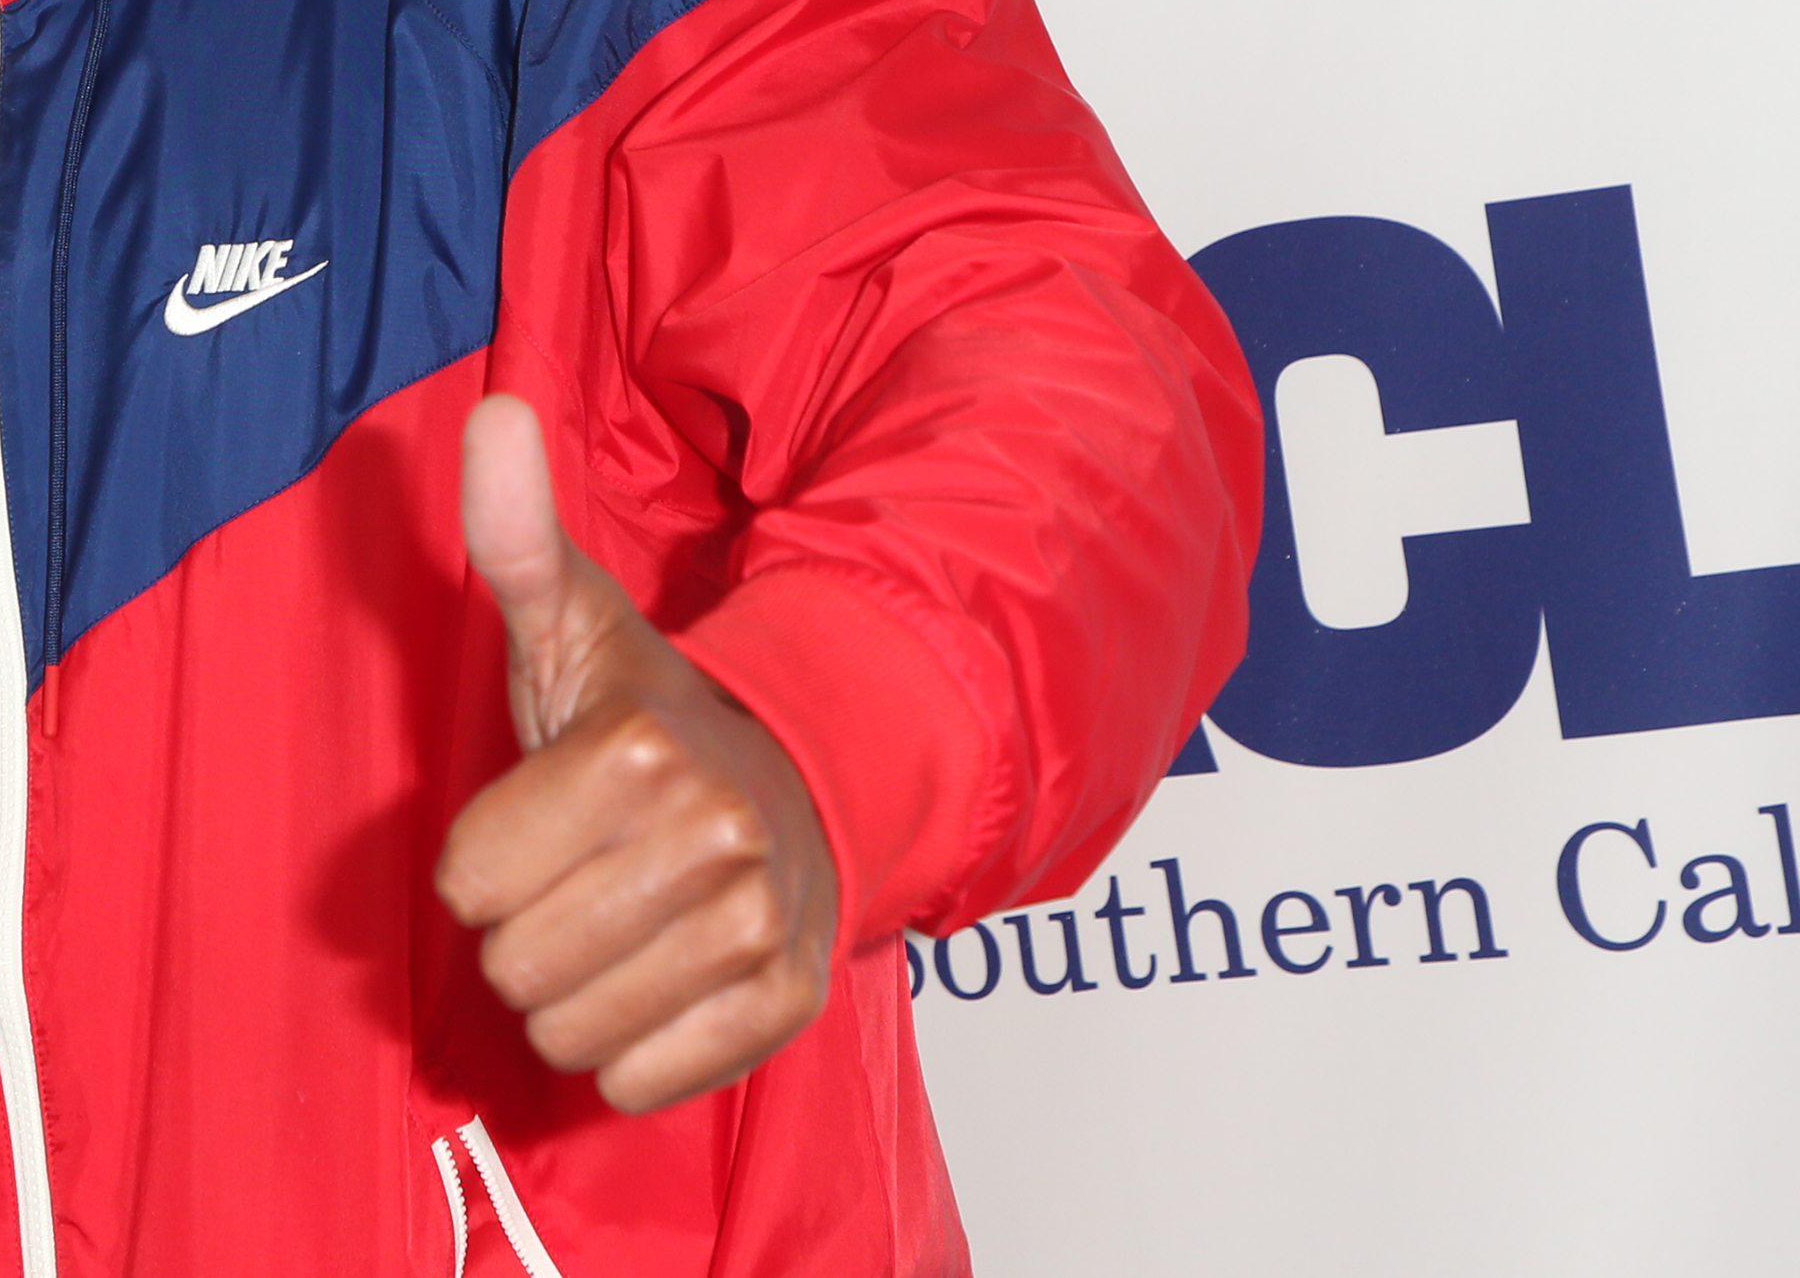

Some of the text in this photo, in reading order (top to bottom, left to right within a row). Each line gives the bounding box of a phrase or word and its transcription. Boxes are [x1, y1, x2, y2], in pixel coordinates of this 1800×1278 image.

[186, 239, 294, 295] NIKE
[1164, 184, 1800, 778] CL
[904, 858, 1509, 1002] outhern
